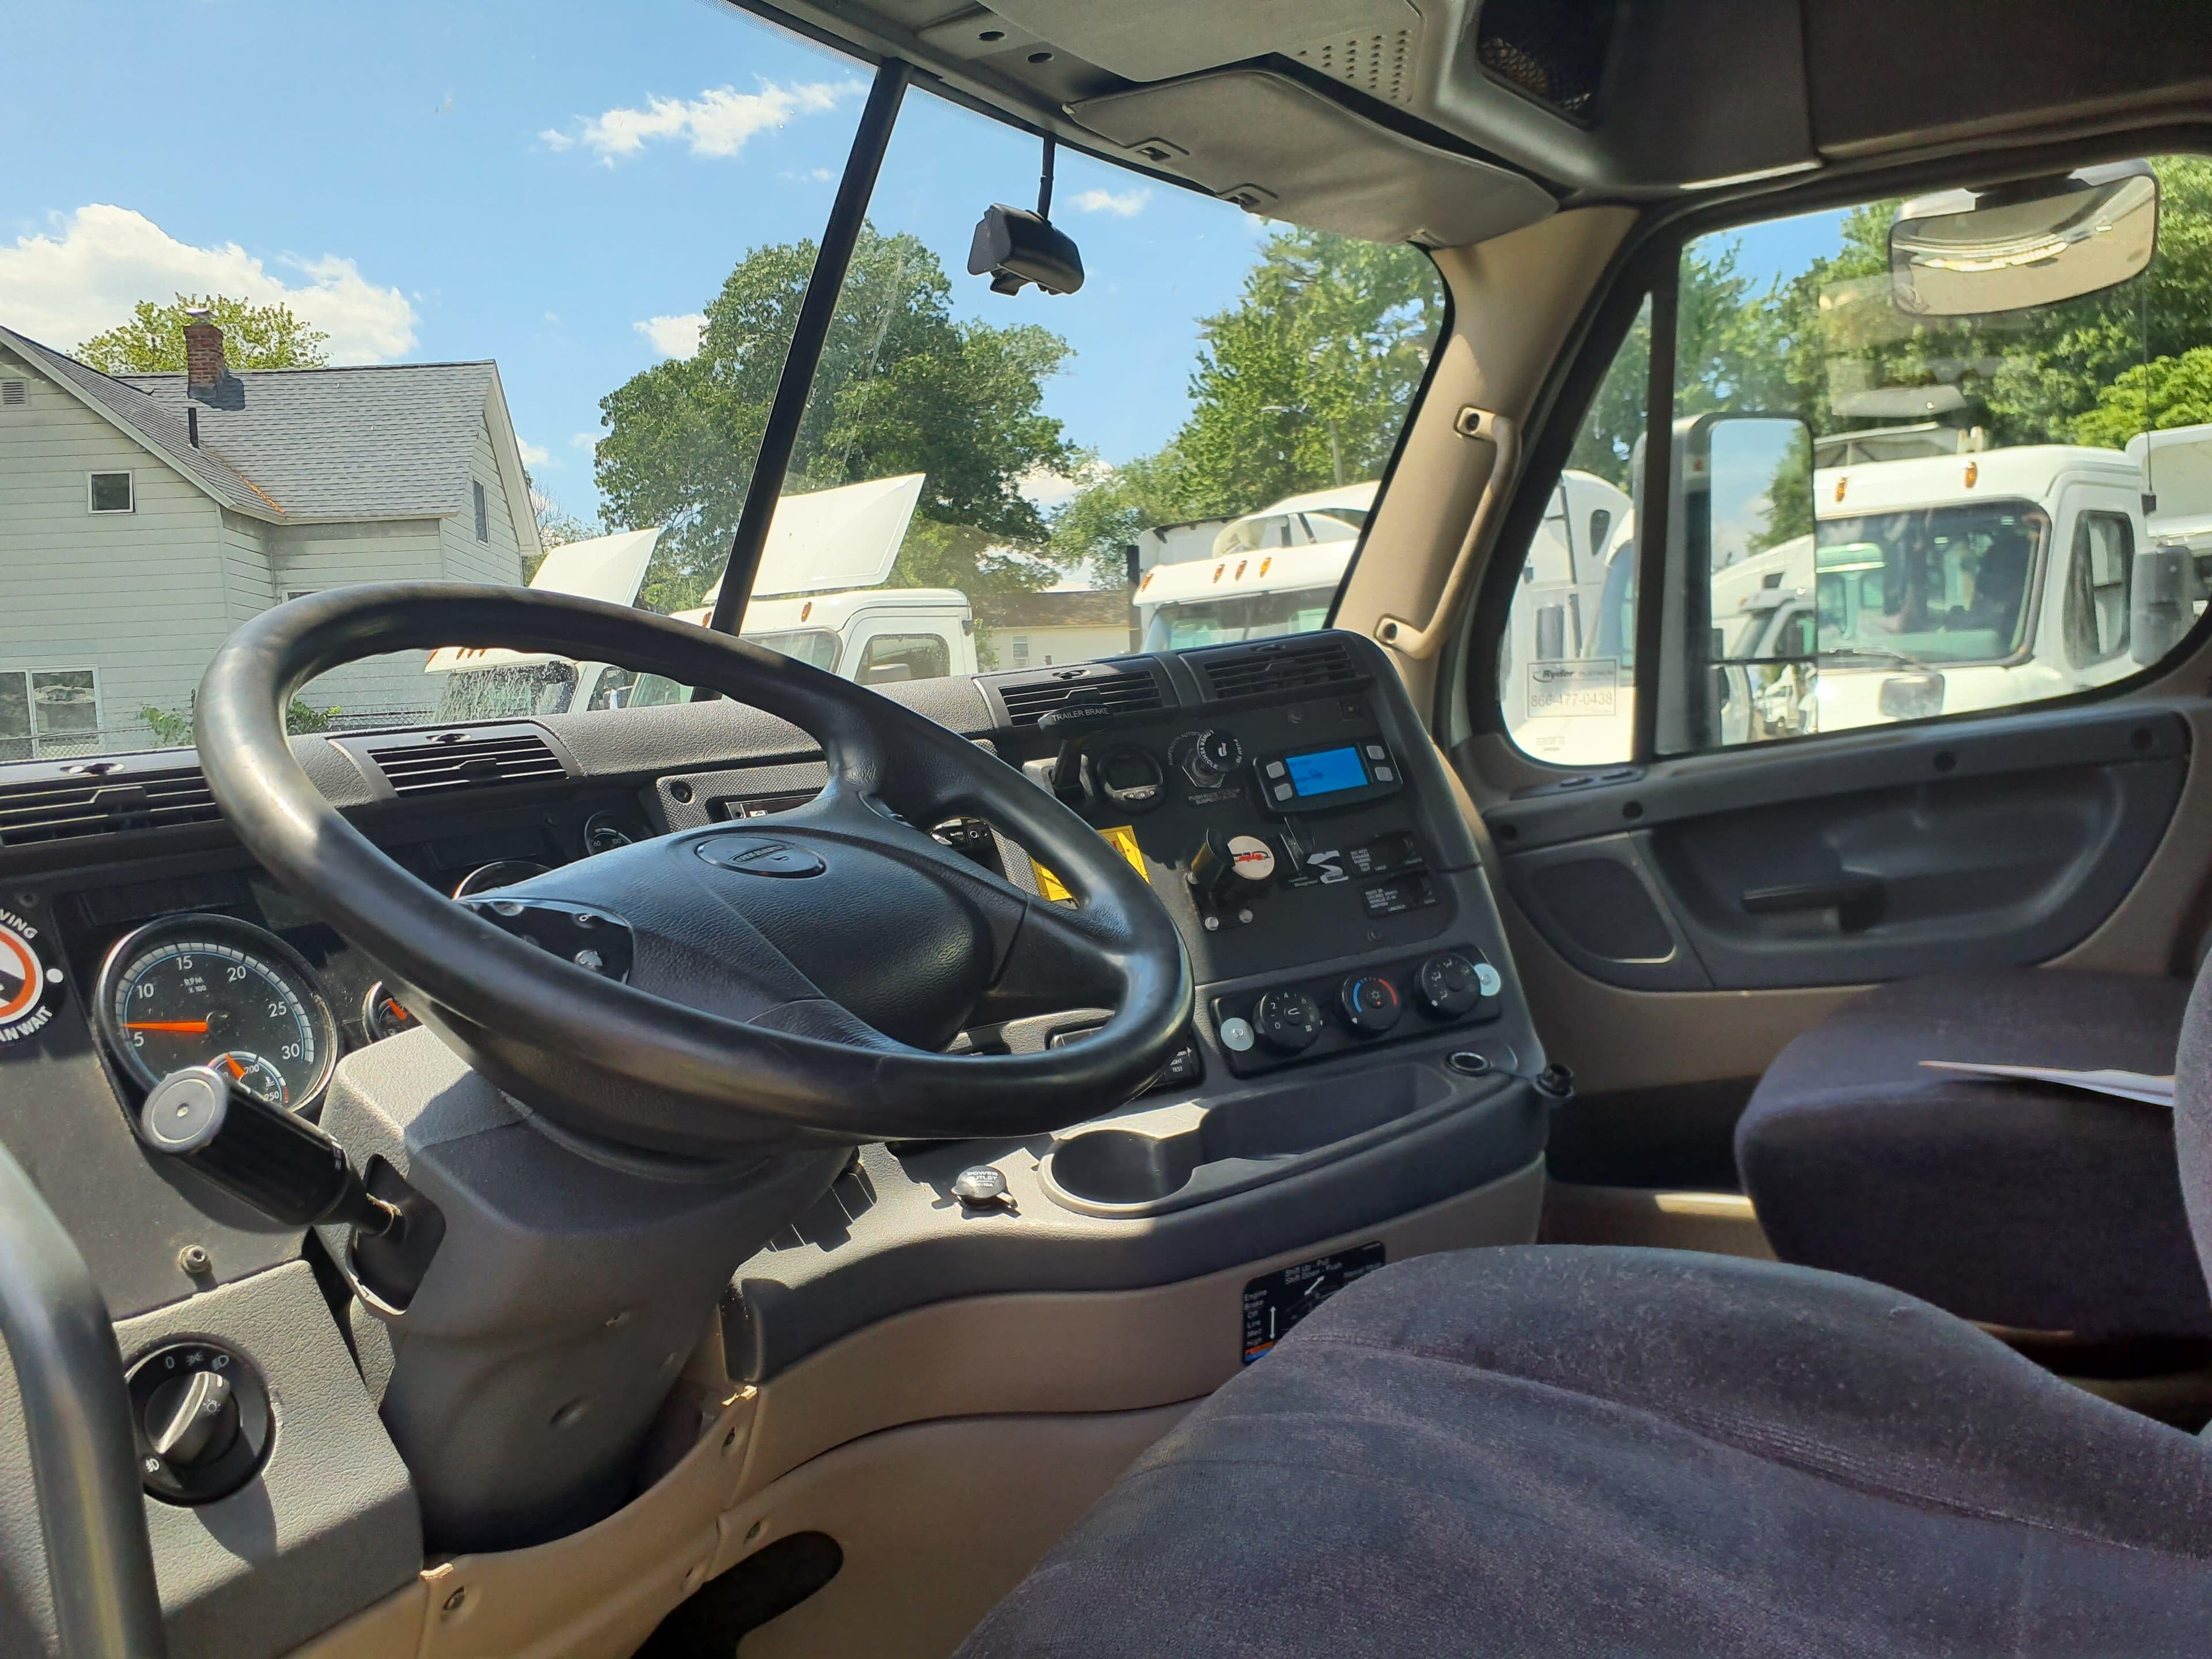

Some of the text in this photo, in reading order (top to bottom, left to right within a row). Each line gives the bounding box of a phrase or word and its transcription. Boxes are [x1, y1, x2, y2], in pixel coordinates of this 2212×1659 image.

[1531, 692, 1613, 707] 866-477-0438
[1051, 708, 1109, 722] TRAILER BRAKE
[1200, 747, 1218, 770] VEHICLE
[176, 956, 193, 971] 15
[184, 976, 204, 986] RPM
[226, 966, 247, 982] 20
[137, 983, 154, 999] 10
[268, 1001, 287, 1017] 25
[16, 1005, 52, 1036] WAIT
[1274, 1021, 1281, 1029] 0
[133, 1032, 144, 1047] 5
[281, 1043, 300, 1059] 30
[244, 1064, 259, 1074] 200
[264, 1091, 279, 1101] 250
